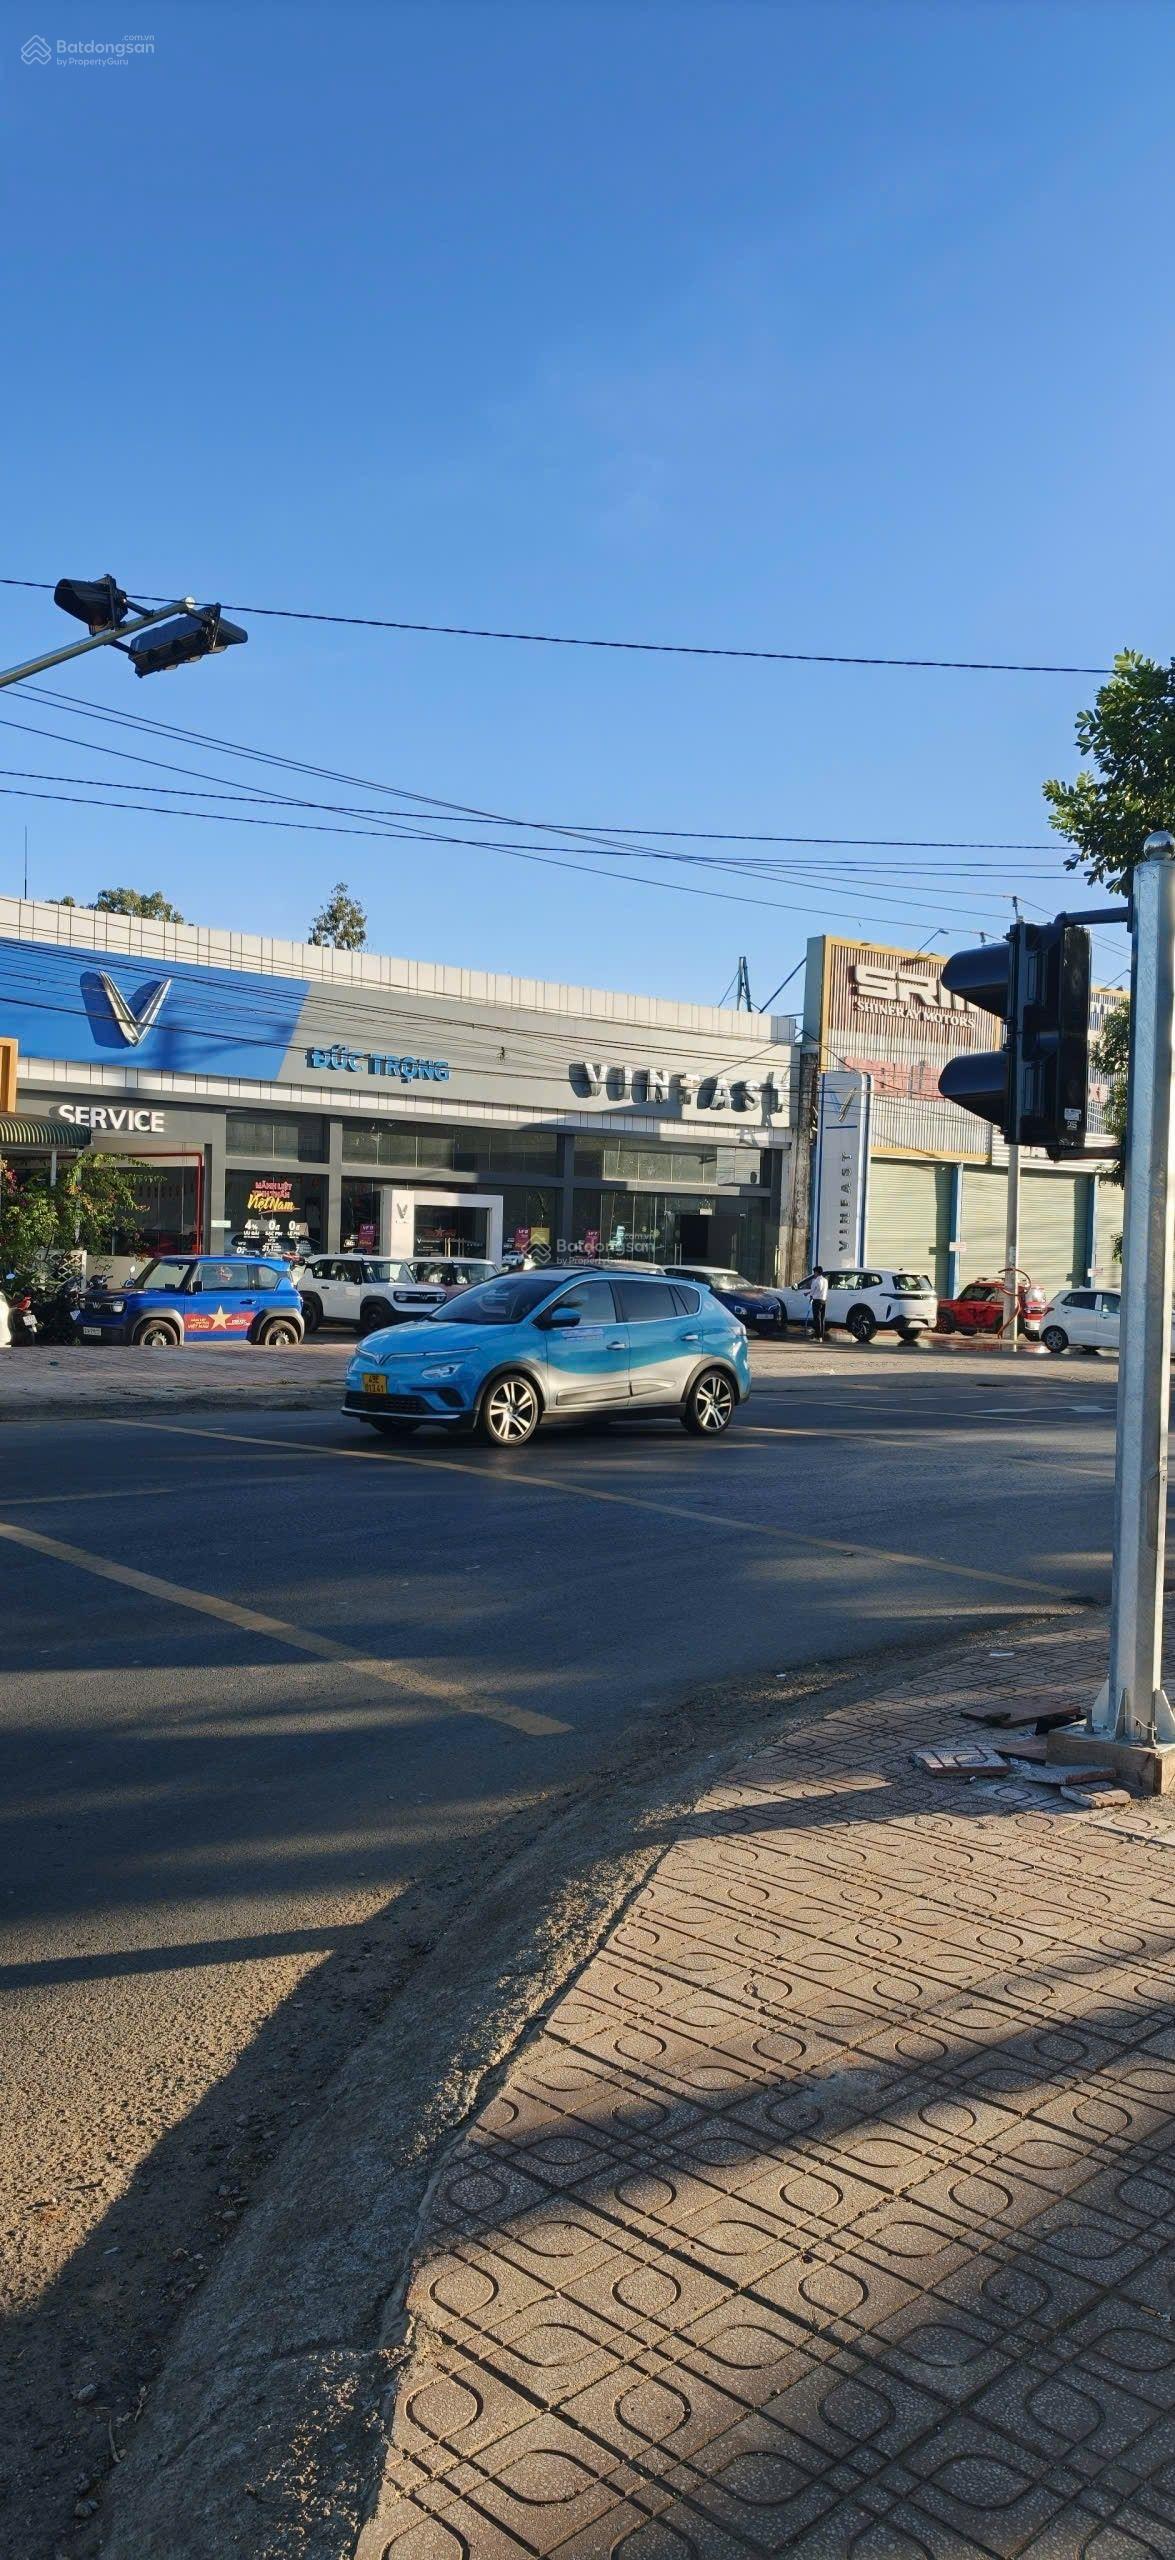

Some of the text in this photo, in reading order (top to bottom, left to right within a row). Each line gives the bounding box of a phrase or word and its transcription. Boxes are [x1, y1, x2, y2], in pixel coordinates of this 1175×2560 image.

[856, 1001, 976, 1028] SHINERAY MOTORS
[306, 1044, 450, 1083] ĐỨC TRỌNG
[582, 1061, 789, 1113] VINFAST
[58, 1104, 165, 1133] SERVICE
[838, 1151, 852, 1253] VINFAST
